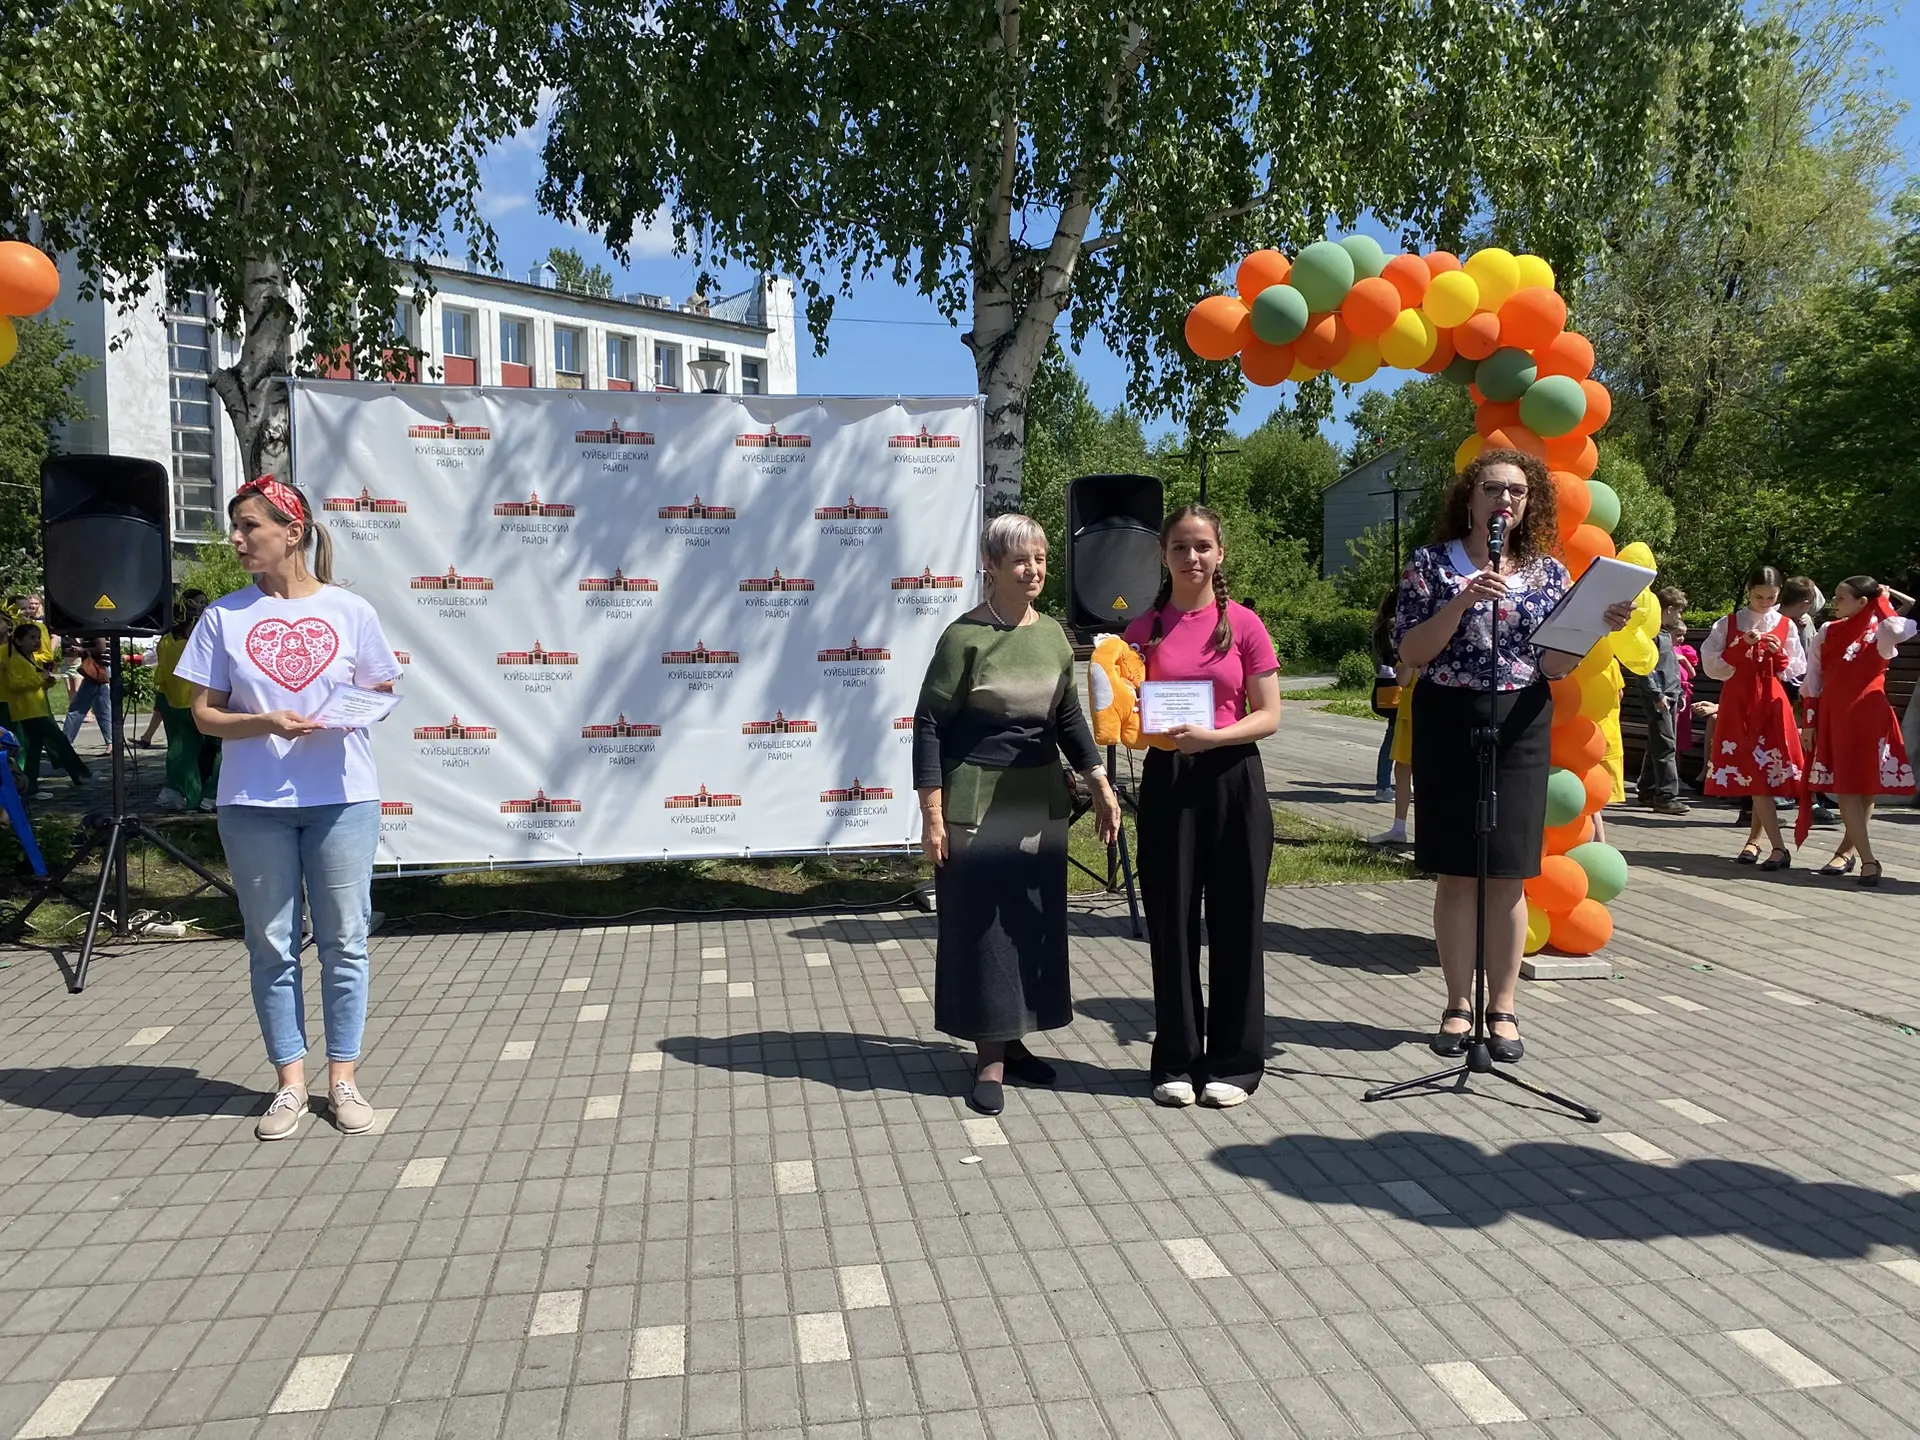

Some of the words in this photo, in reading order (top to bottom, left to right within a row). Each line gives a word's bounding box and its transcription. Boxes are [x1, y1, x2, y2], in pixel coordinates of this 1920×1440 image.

[414, 444, 485, 457] КУЙБЫШЕВСКИЙ
[581, 448, 649, 461] КУЙБЫШЕВСКИЙ
[741, 451, 806, 463] КУЙБЫШЕВСКИЙ
[894, 452, 955, 463] КУЙБЫШЕВСКИЙ
[436, 457, 465, 469] РАЙОН
[602, 461, 629, 473] РАЙОН
[761, 464, 787, 475] РАЙОН
[913, 464, 937, 475] РАЙОН
[329, 518, 401, 530] КУЙБЫШЕВСКИЙ
[500, 522, 570, 534] КУЙБЫШЕВСКИЙ
[664, 523, 730, 535] КУЙБЫШЕВСКИЙ
[820, 524, 883, 535] КУЙБЫШЕВСКИЙ
[351, 529, 379, 542] РАЙОН
[521, 534, 549, 545] РАЙОН
[684, 536, 710, 547] РАЙОН
[839, 536, 864, 547] РАЙОН
[416, 596, 488, 607] КУЙБЫШЕВСКИЙ
[585, 597, 653, 609] КУЙБЫШЕВСКИЙ
[745, 595, 809, 607] КУЙБЫШЕВСКИЙ
[897, 593, 958, 604] КУЙБЫШЕВСКИЙ
[438, 608, 467, 619] РАЙОН
[606, 608, 633, 620] РАЙОН
[764, 608, 790, 619] РАЙОН
[915, 605, 940, 616] РАЙОН
[503, 670, 573, 681] КУЙБЫШЕВСКИЙ
[667, 668, 733, 679] КУЙБЫШЕВСКИЙ
[823, 665, 886, 677] КУЙБЫШЕВСКИЙ
[524, 683, 552, 693] РАЙОН
[688, 681, 714, 691] РАЙОН
[842, 678, 867, 688] РАЙОН
[588, 742, 656, 753] КУЙБЫШЕВСКИЙ
[748, 738, 812, 749] КУЙБЫШЕВСКИЙ
[420, 745, 491, 755] КУЙБЫШЕВСКИЙ
[609, 755, 635, 766] РАЙОН
[767, 751, 792, 761] РАЙОН
[442, 757, 470, 768] РАЙОН
[826, 805, 888, 817] КУЙБЫШЕВСКИЙ
[506, 817, 576, 829] КУЙБЫШЕВСКИЙ
[670, 812, 736, 823] КУЙБЫШЕВСКИЙ
[845, 818, 869, 828] РАЙОН
[527, 830, 555, 841] РАЙОН
[690, 825, 716, 835] РАЙОН
